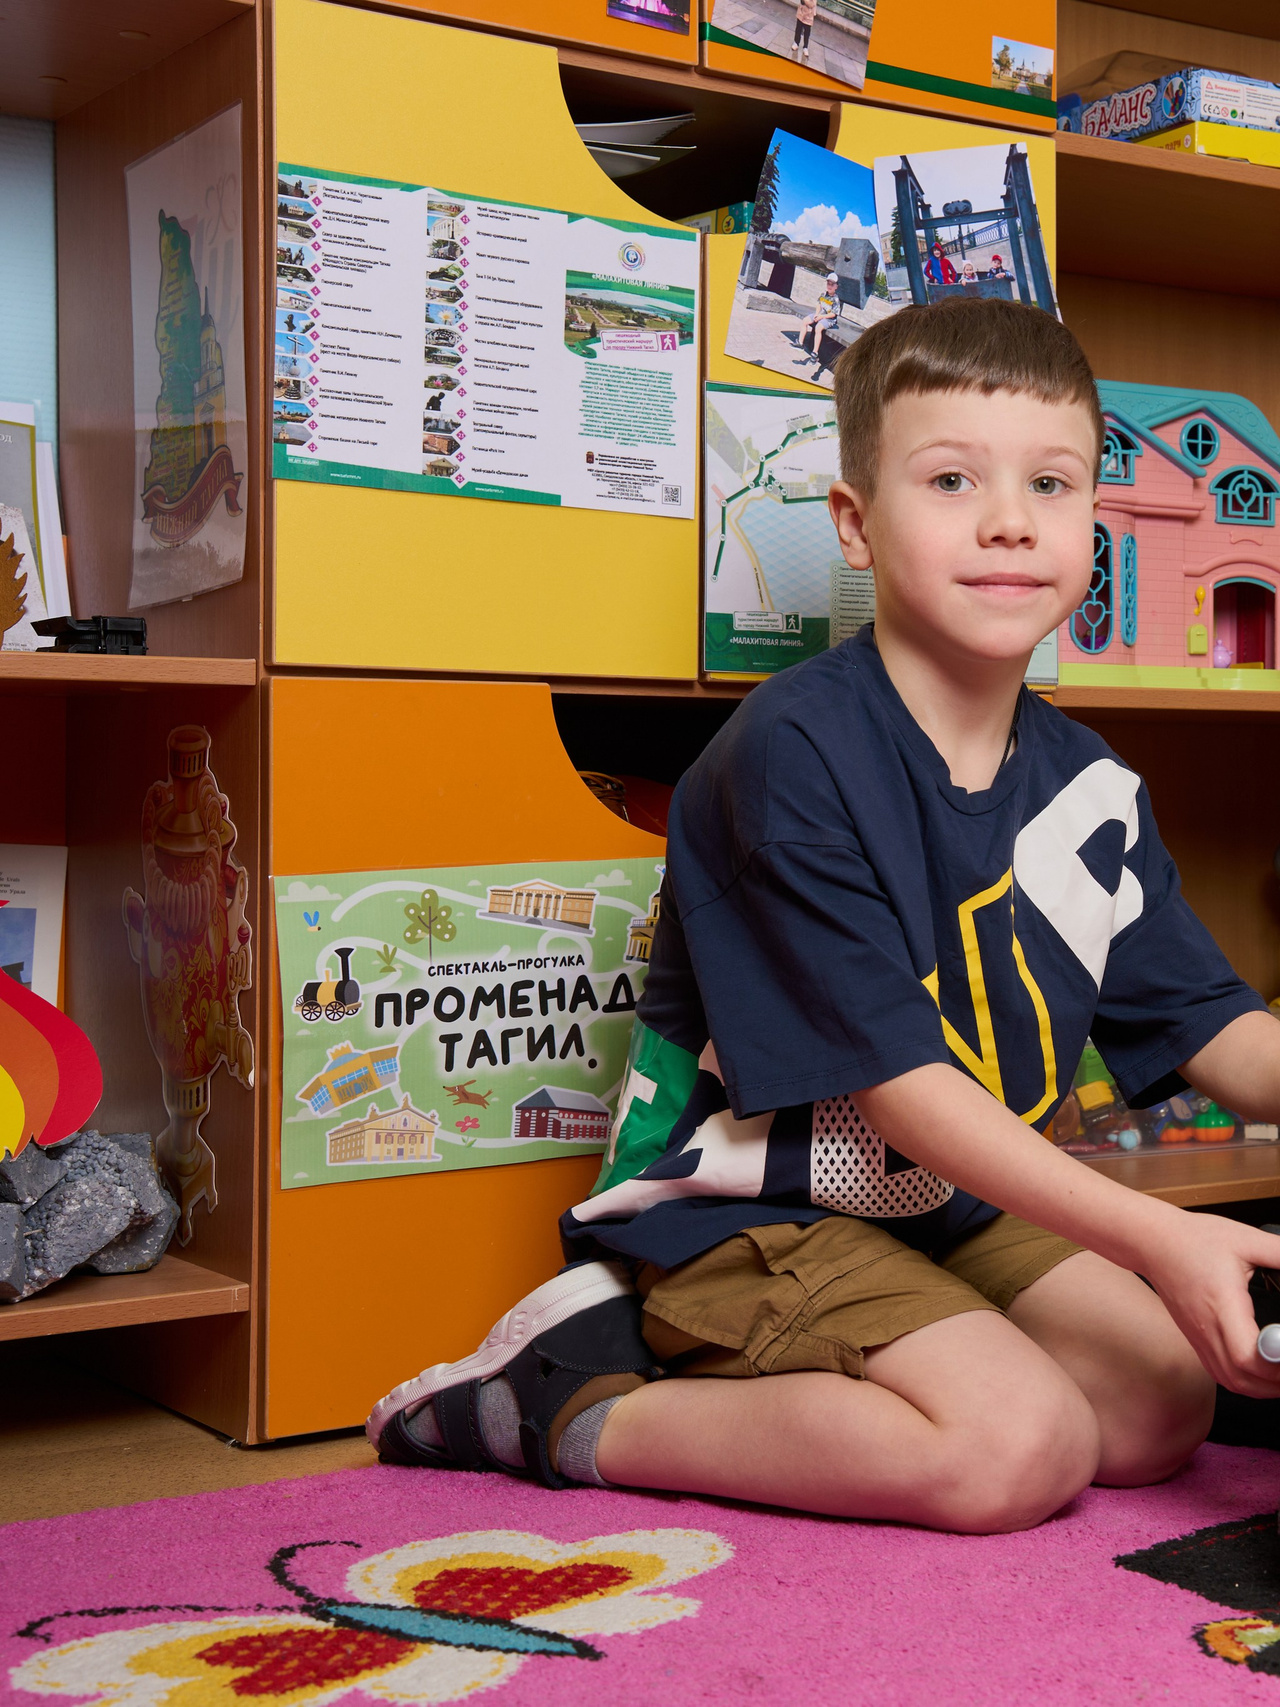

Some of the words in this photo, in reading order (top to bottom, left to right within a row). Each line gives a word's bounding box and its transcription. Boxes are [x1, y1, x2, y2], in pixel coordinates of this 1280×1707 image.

[1084, 88, 1154, 136] БАЛАНС
[592, 272, 642, 286] «МАЛАХИТОВАЯ
[643, 281, 669, 291] ЛИНИЯ»
[156, 500, 198, 535] НИЖНИЙ
[200, 459, 229, 513] ТАГИЛ
[730, 637, 778, 646] «МАЛАХИТОВАЯ
[780, 639, 804, 647] ЛИНИЯ»
[428, 954, 585, 977] СПЕКТАКЛЬ-ПРОГУЛКА
[374, 973, 638, 1028] ПРОМЕНАД
[438, 1023, 598, 1072] ТАГИЛ.
